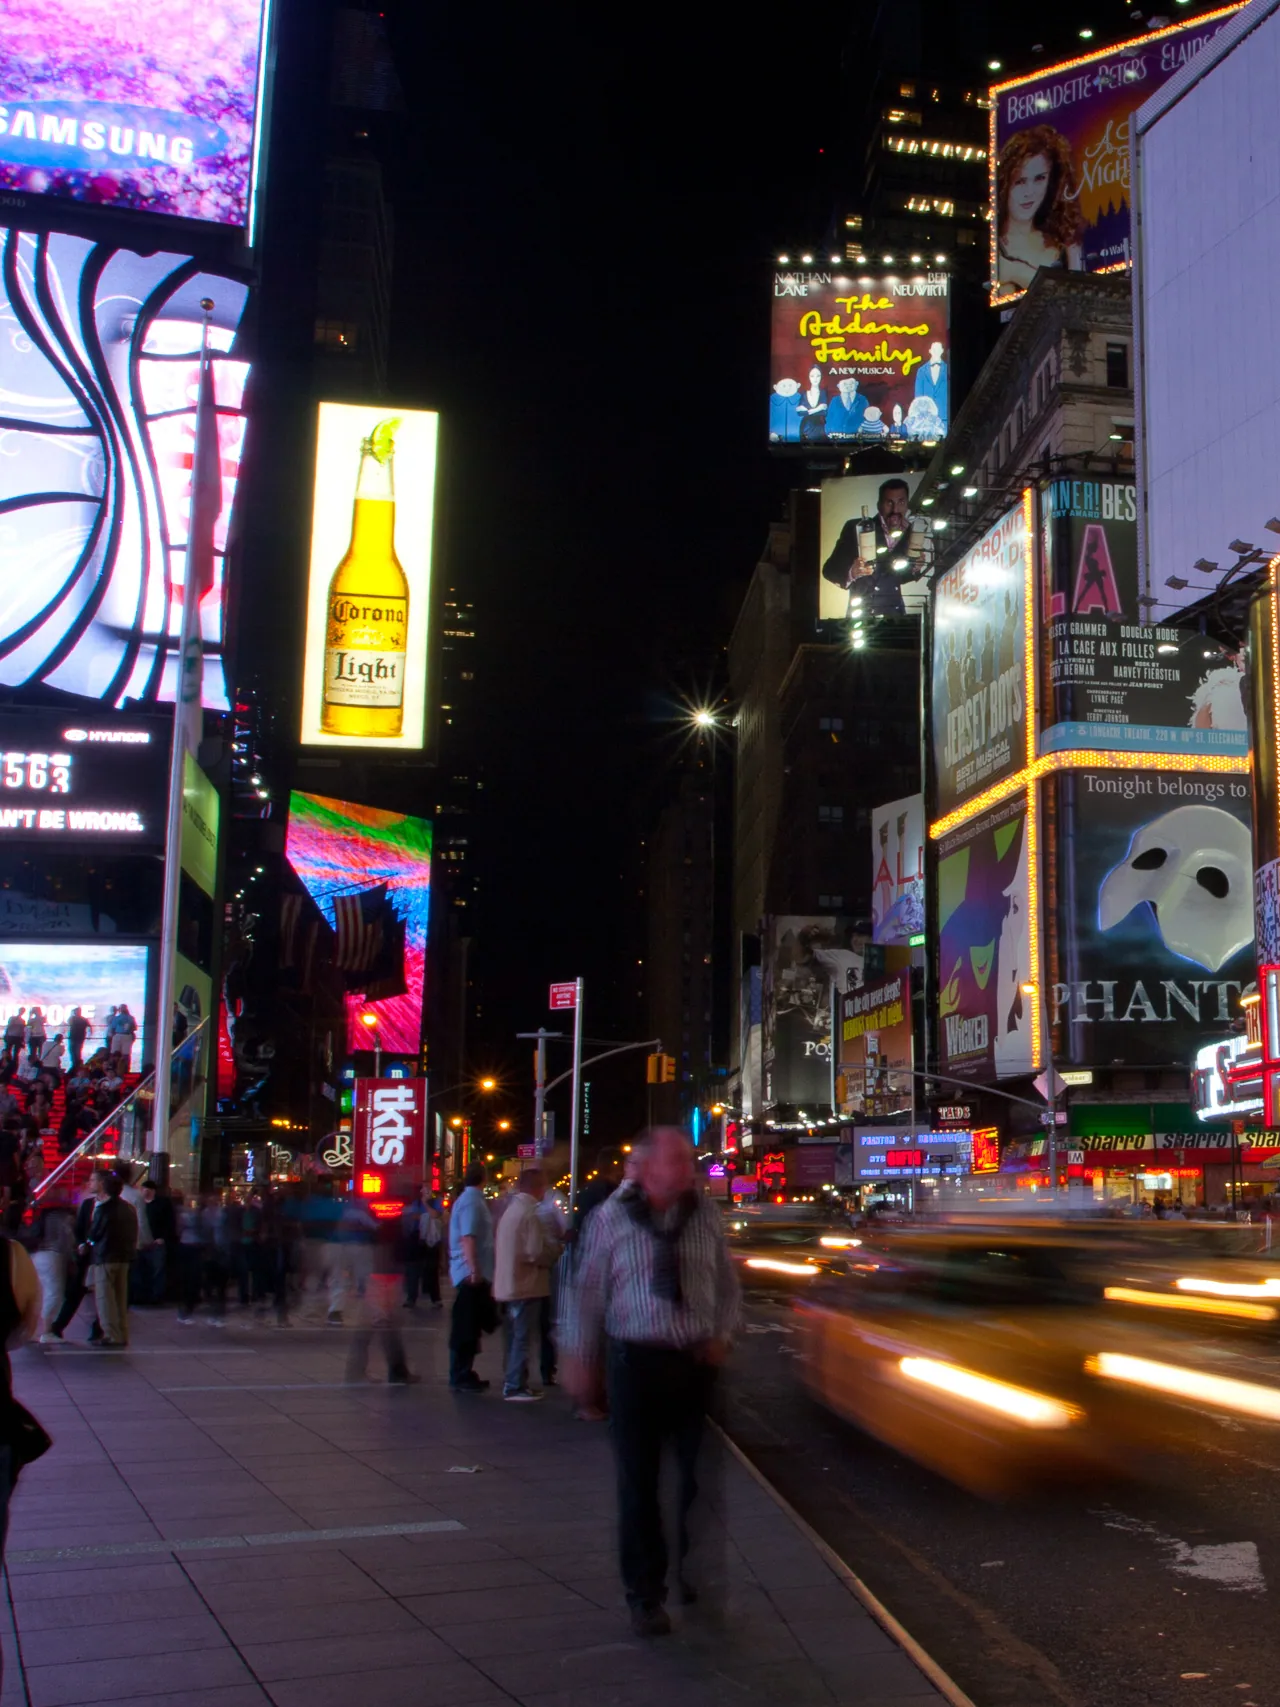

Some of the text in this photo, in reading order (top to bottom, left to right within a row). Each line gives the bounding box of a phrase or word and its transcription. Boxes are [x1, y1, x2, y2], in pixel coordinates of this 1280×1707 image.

[775, 273, 832, 284] NATHAN
[774, 285, 808, 297] LANE
[835, 293, 895, 314] The
[800, 311, 930, 337] Addams
[810, 336, 922, 376] Family
[333, 600, 404, 625] Corona
[1070, 622, 1180, 642] GRAMMER DOUGLAS HODGE
[1059, 639, 1155, 660] LA CAGE AUX FOLLES
[335, 652, 397, 683] Light
[1064, 663, 1095, 677] HERMAN
[1113, 665, 1180, 682] HARVEY FIERSTEIN
[88, 731, 151, 744] HYUNDAI
[956, 737, 1010, 783] BEST MUSICAL
[1084, 775, 1225, 802] Tonight belongs
[39, 811, 145, 832] BE WRONG.
[372, 1085, 416, 1166] tkts
[1081, 1132, 1146, 1151] sbarro
[1163, 1131, 1229, 1150] sbarro
